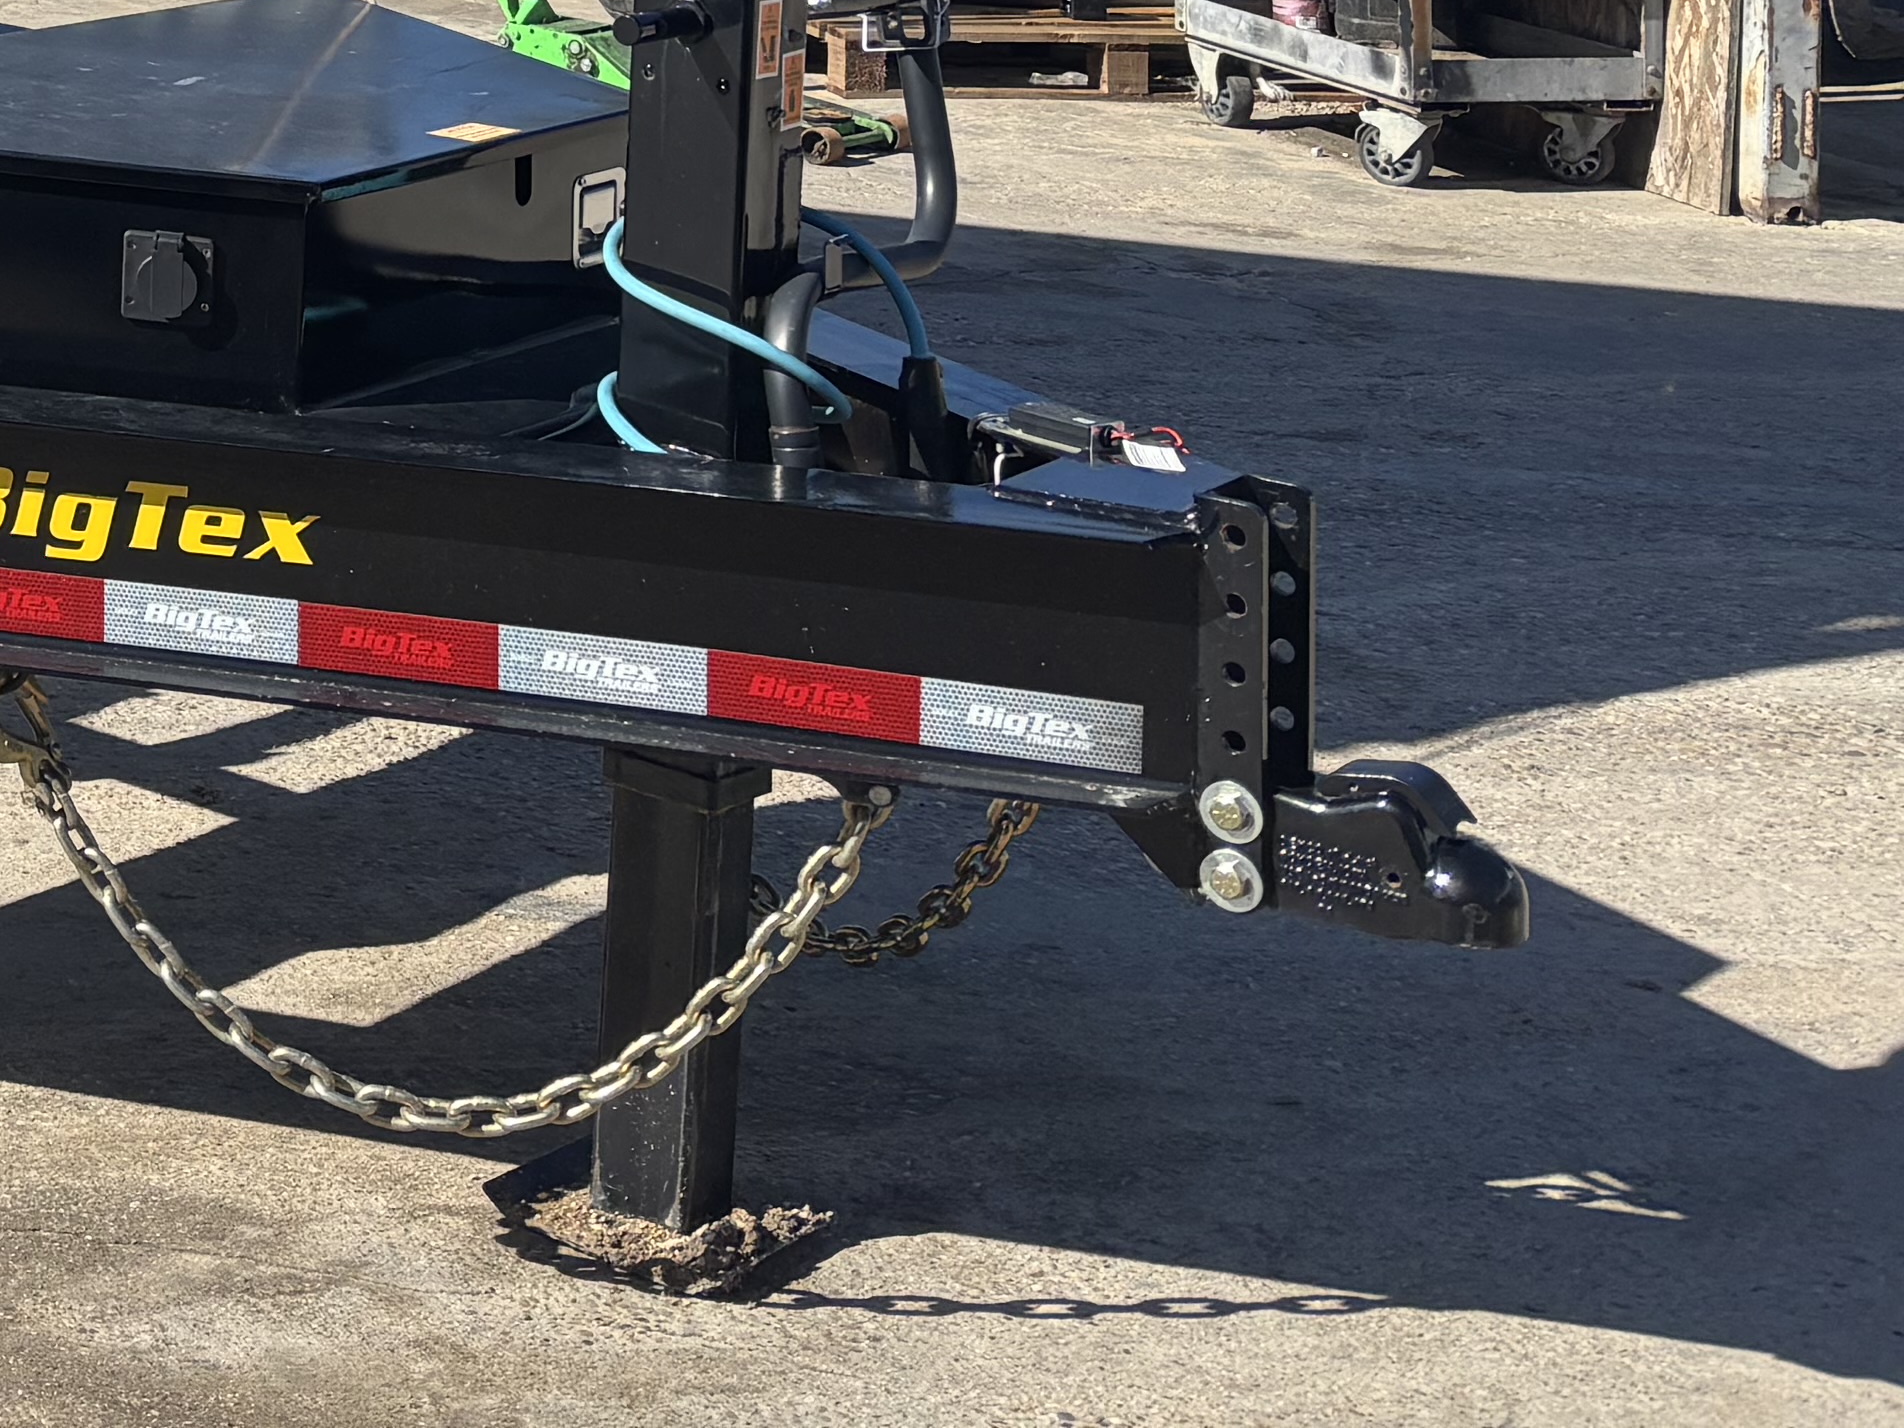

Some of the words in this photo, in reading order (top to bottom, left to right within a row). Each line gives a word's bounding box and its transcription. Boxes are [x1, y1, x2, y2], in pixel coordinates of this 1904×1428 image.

[143, 602, 257, 635] BigTex
[342, 625, 453, 659] BigTex
[542, 649, 659, 682] BigTex
[746, 674, 873, 710] BigTex
[966, 703, 1093, 740] BigTex
